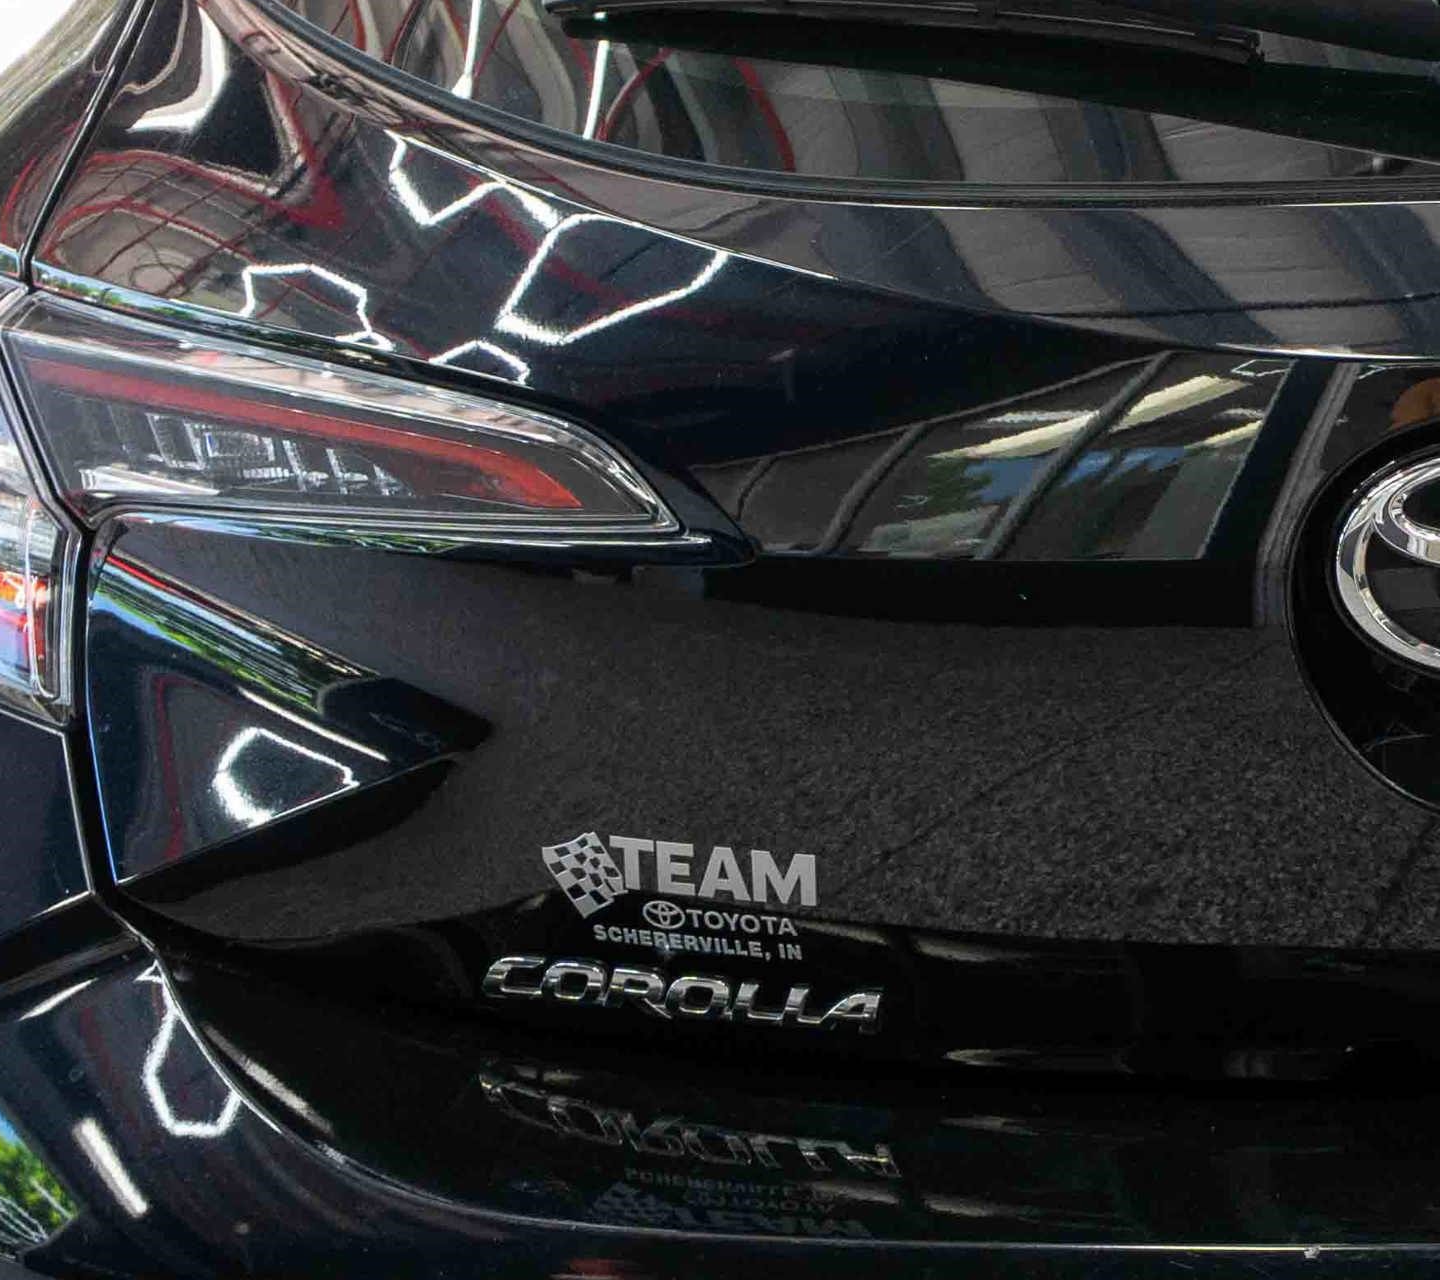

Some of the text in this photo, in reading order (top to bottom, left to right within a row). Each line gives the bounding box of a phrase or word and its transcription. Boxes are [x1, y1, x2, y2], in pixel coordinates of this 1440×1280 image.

[609, 835, 817, 907] TEAM
[593, 924, 803, 961] SCHERERVILLE, IN
[686, 909, 798, 936] TOYOTA
[481, 955, 882, 1034] COROLLA
